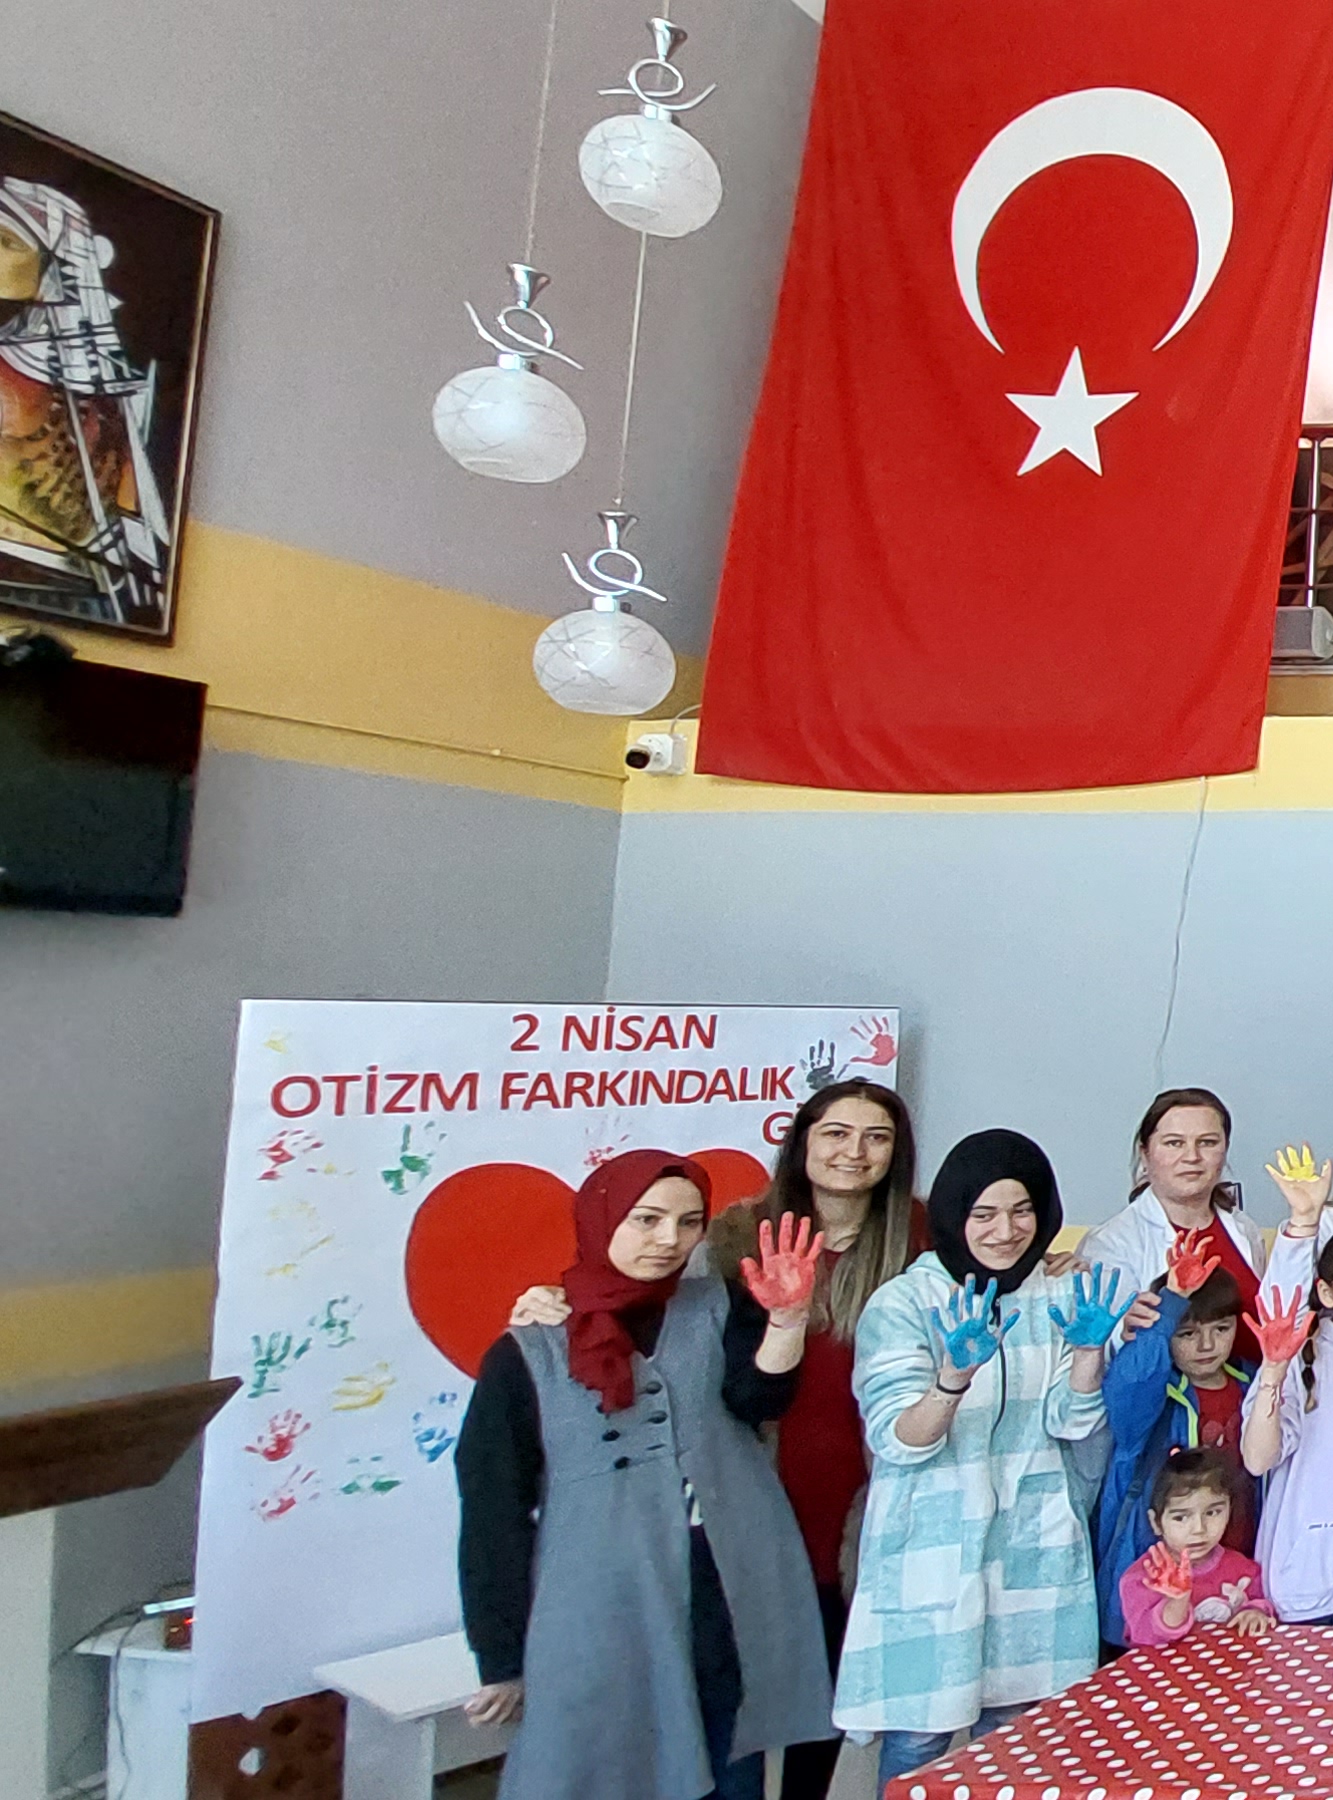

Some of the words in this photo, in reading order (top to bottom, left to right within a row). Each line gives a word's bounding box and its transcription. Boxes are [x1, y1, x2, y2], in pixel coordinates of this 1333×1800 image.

[509, 1013, 541, 1052] 2
[561, 1004, 719, 1053] NİSAN
[270, 1064, 478, 1118] OTİZM
[499, 1064, 797, 1111] FARKINDALIK
